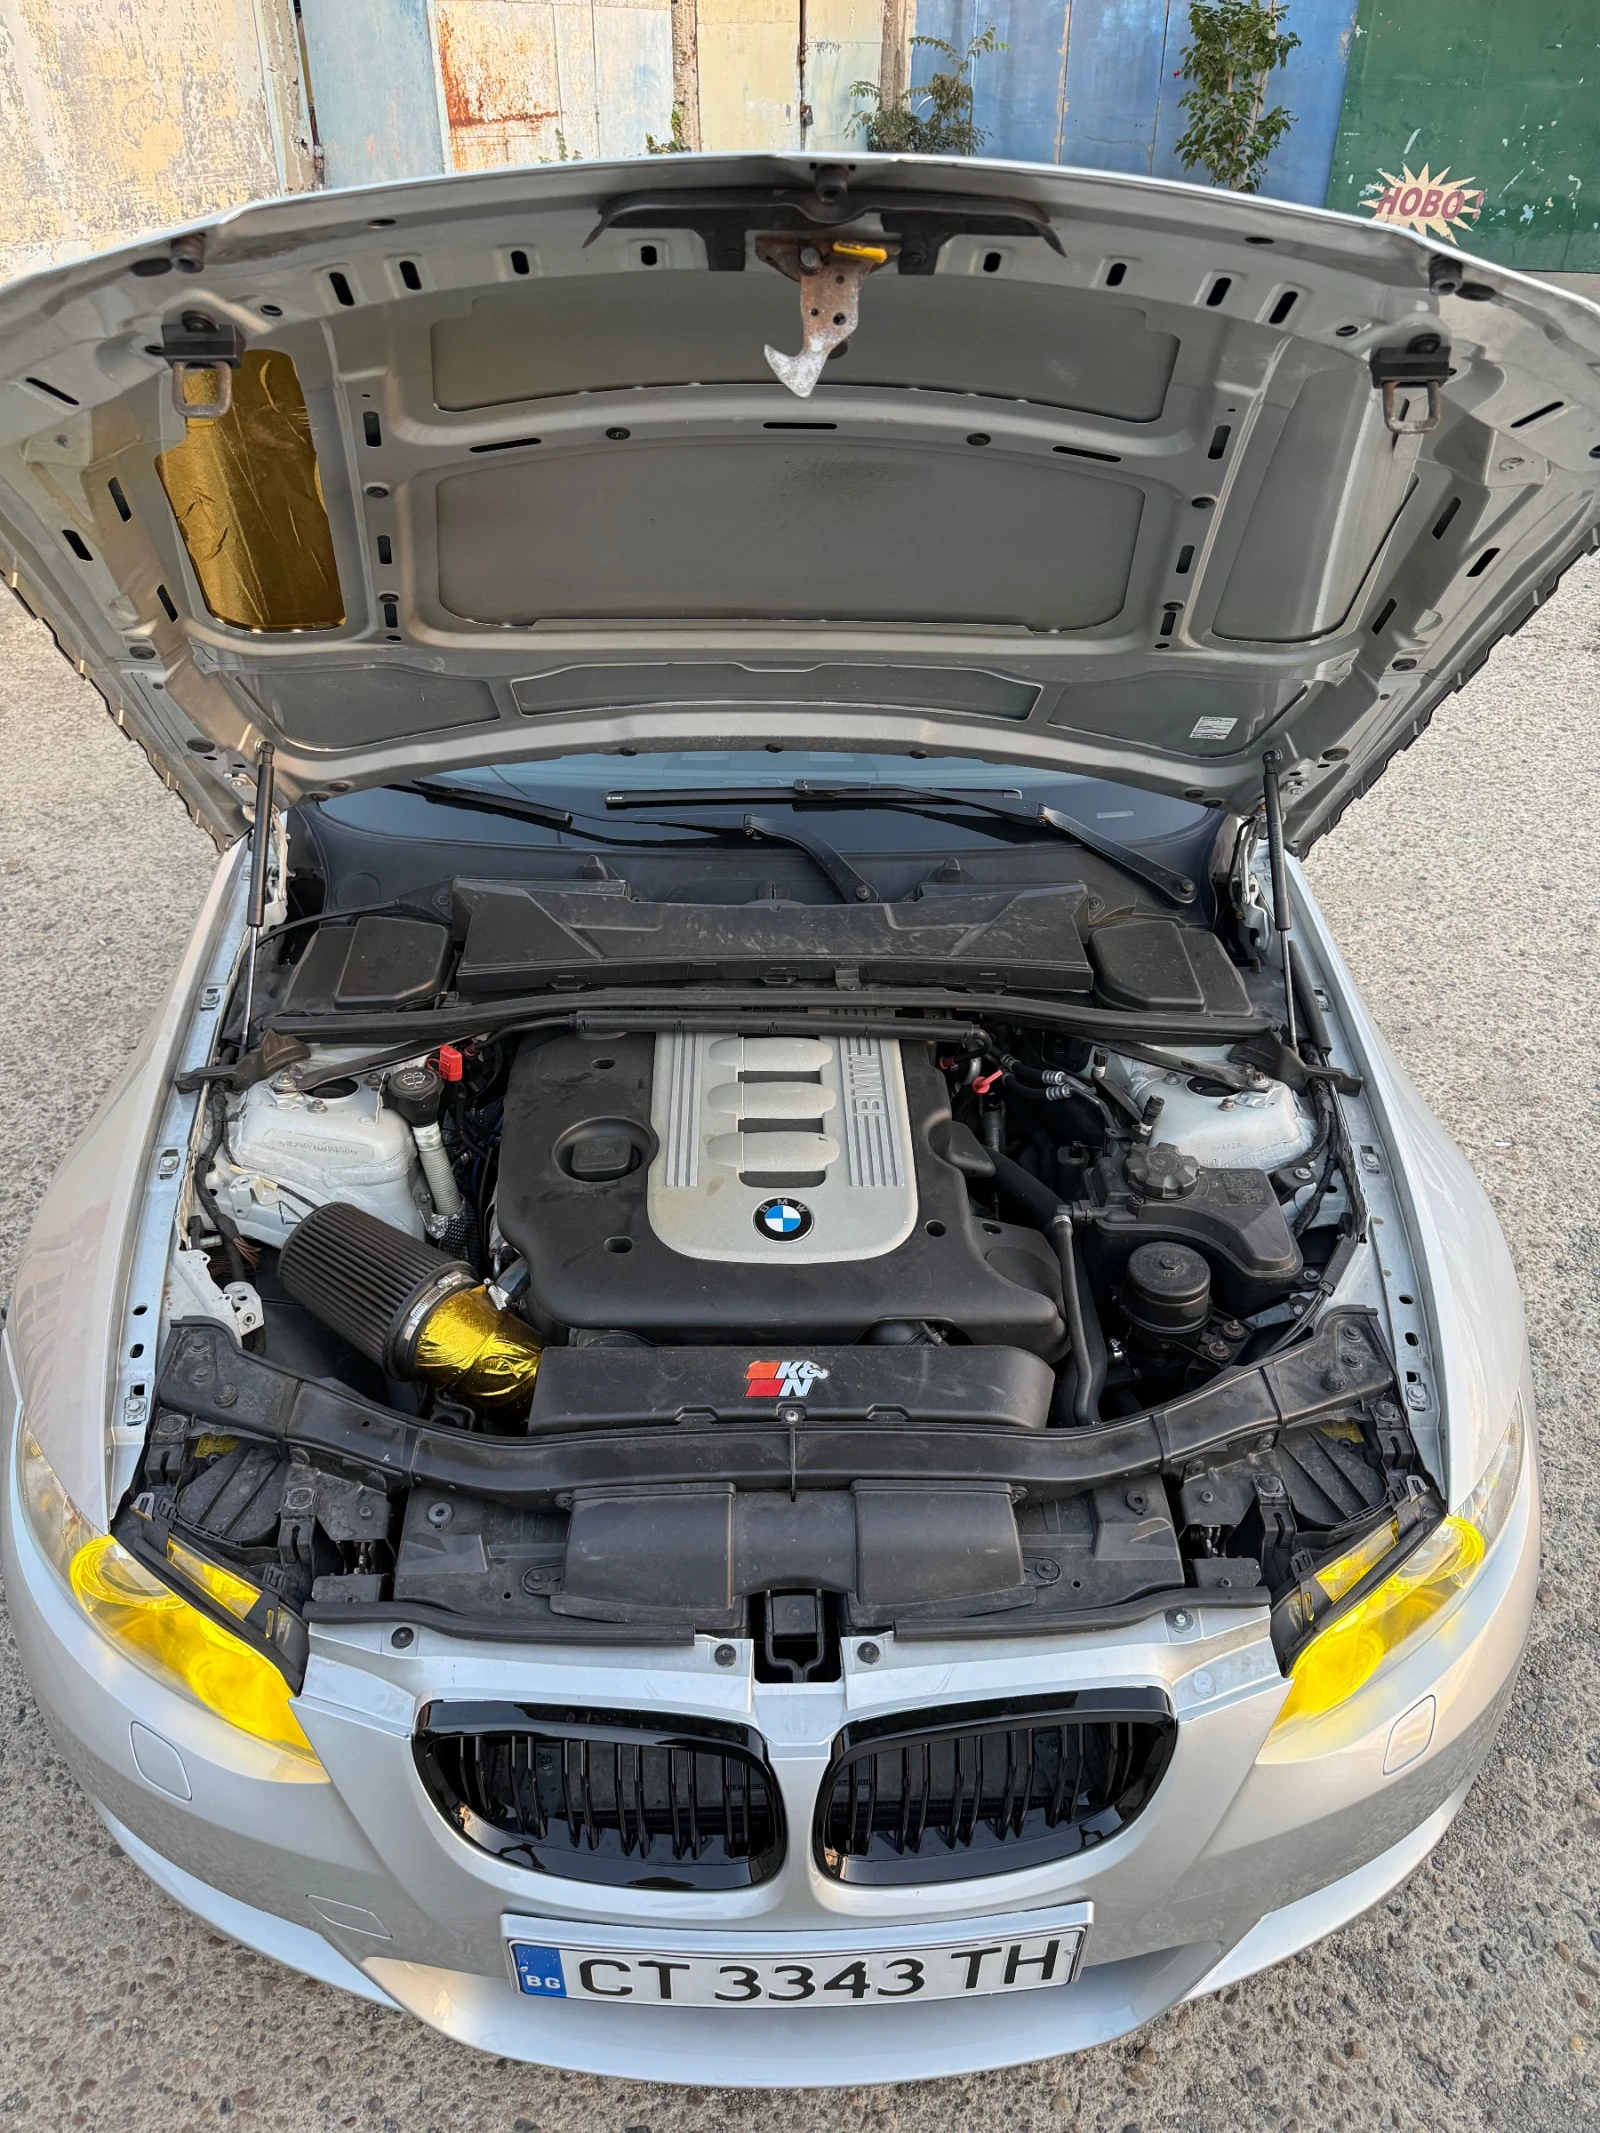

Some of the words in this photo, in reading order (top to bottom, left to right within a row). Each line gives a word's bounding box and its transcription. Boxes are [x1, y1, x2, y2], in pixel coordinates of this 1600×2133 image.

[849, 1054, 885, 1114] BMW
[759, 1199, 808, 1213] BMW
[526, 1974, 561, 1989] BG
[579, 1958, 690, 2000] CT
[714, 1957, 925, 2001] 3343
[950, 1939, 1061, 1990] TH
